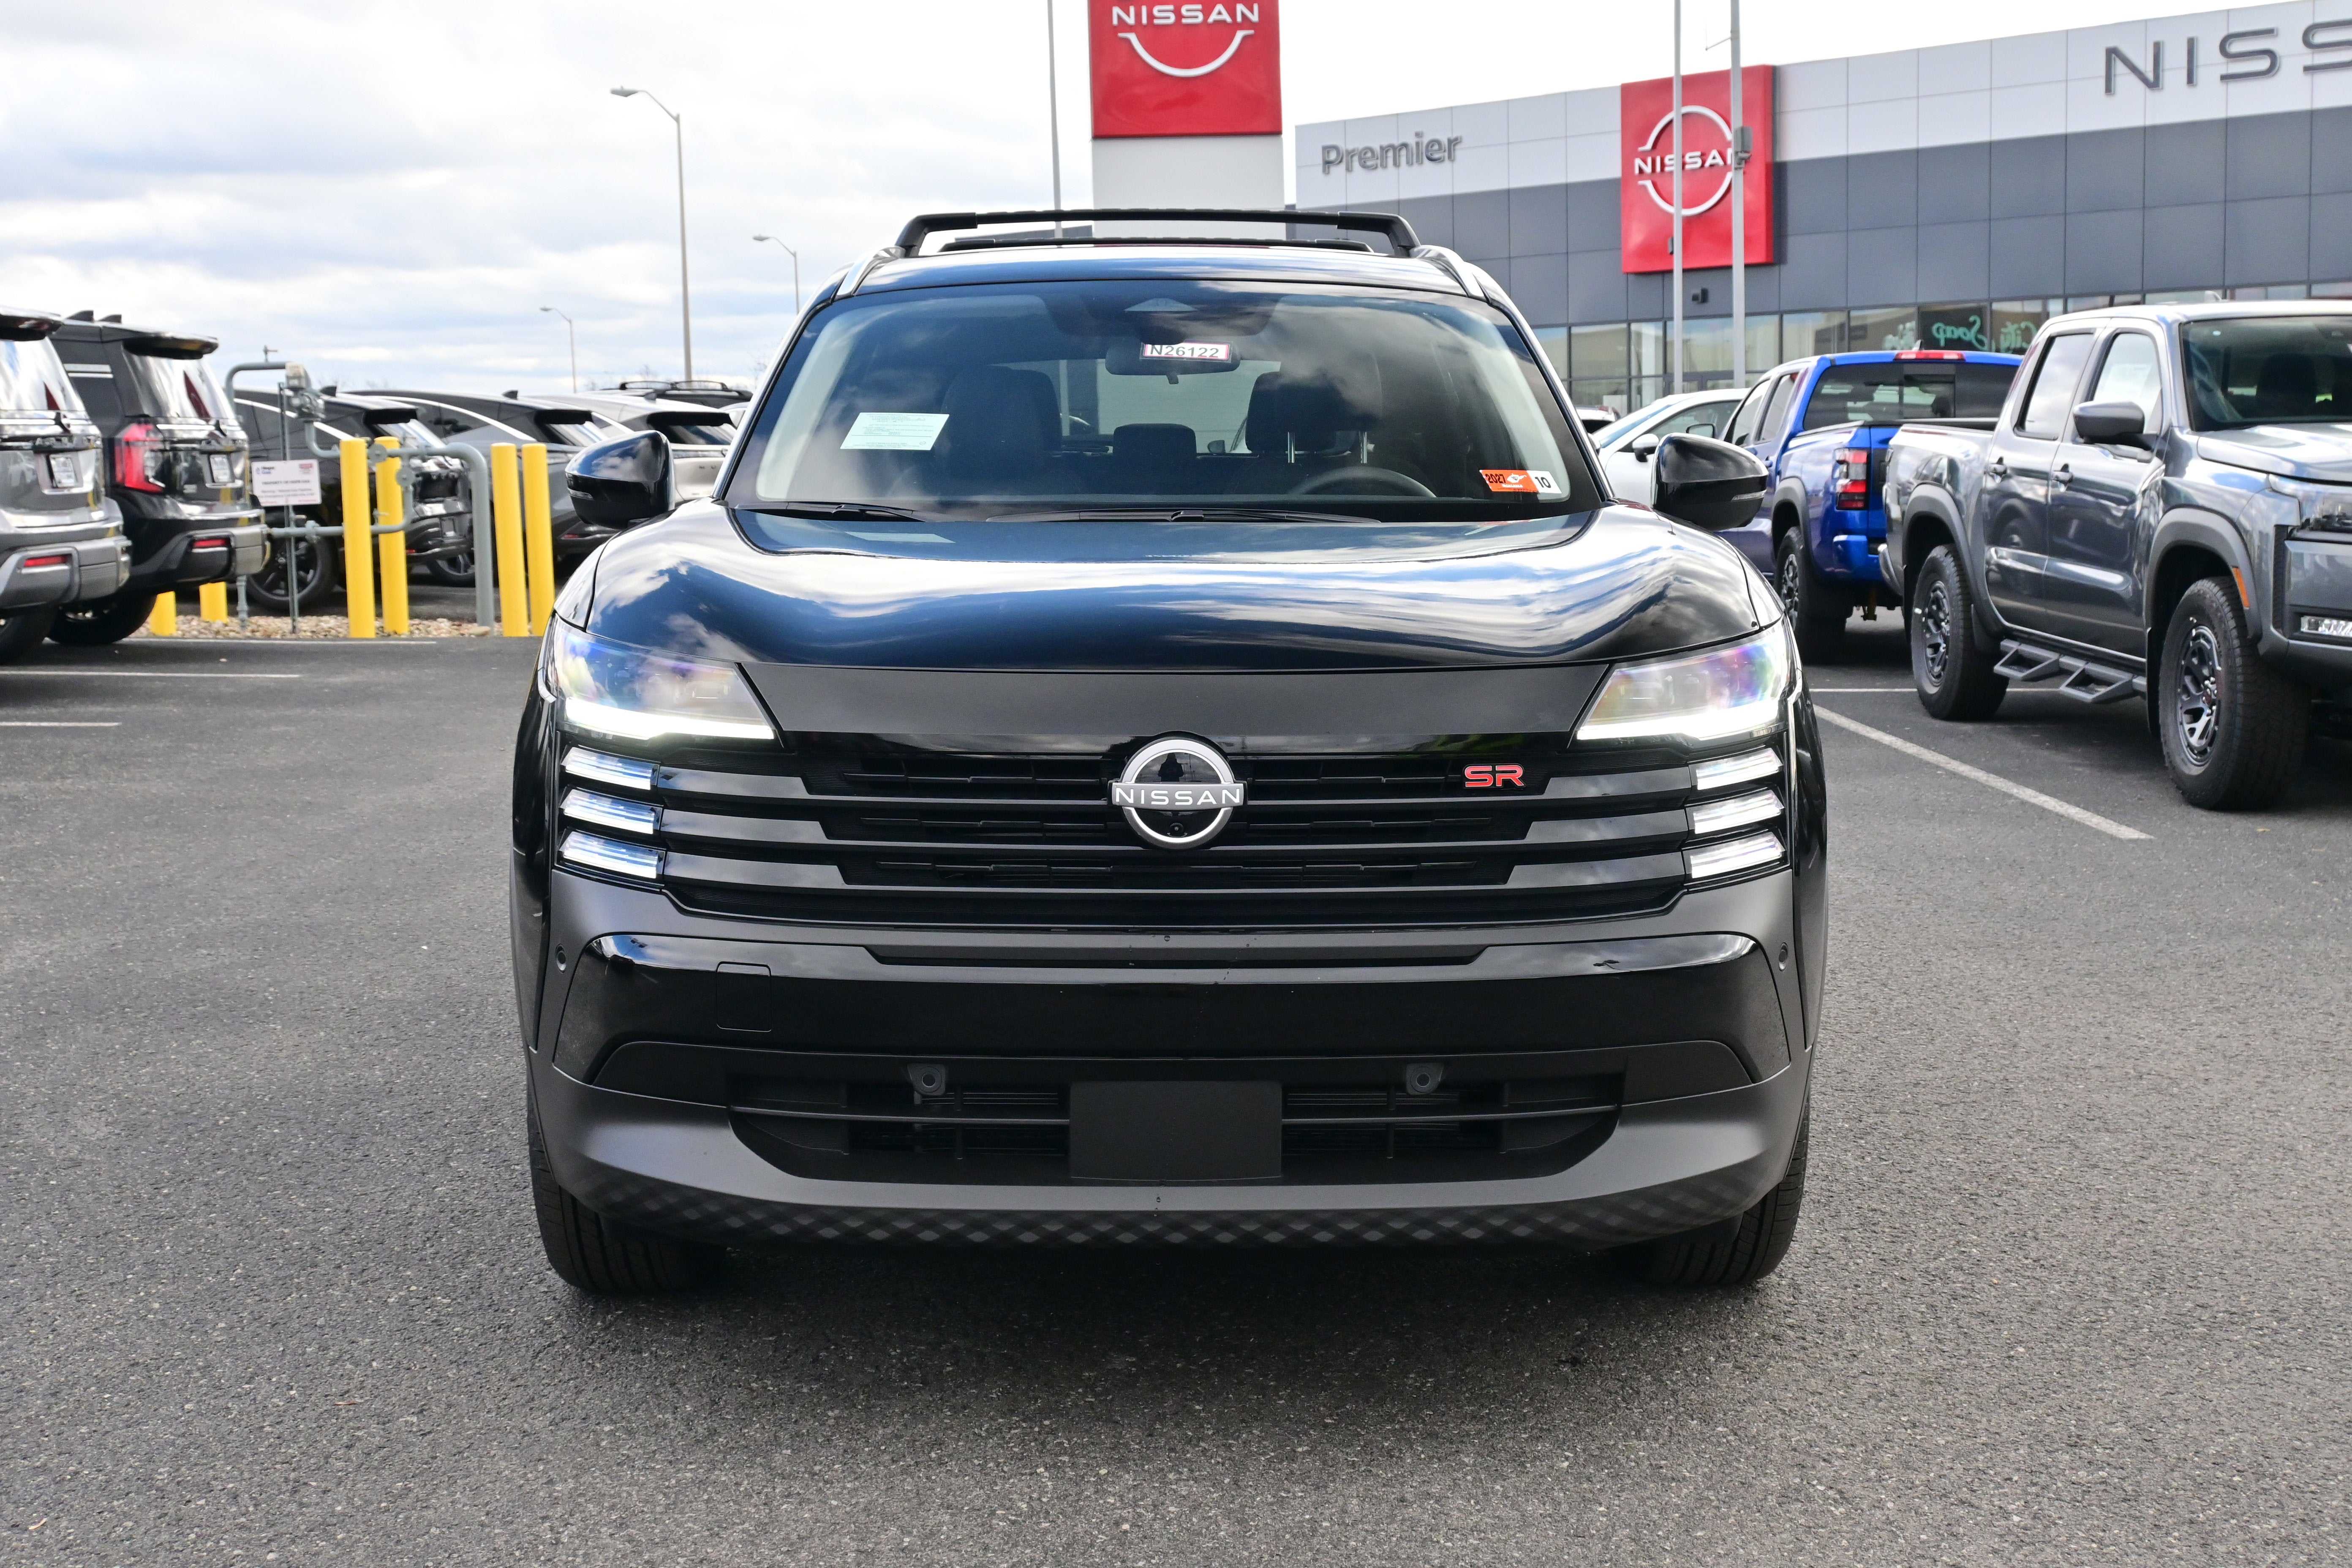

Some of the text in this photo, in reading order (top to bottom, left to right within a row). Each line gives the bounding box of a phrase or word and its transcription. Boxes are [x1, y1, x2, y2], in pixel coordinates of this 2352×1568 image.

[1112, 3, 1259, 25] NISSAN
[2105, 19, 2352, 95] NISS
[1322, 131, 1462, 174] Premier
[1150, 344, 1219, 358] N26122
[1485, 473, 1506, 484] 2027
[1535, 476, 1552, 489] 10
[1464, 765, 1525, 787] SR
[1115, 787, 1240, 806] NISSAN
